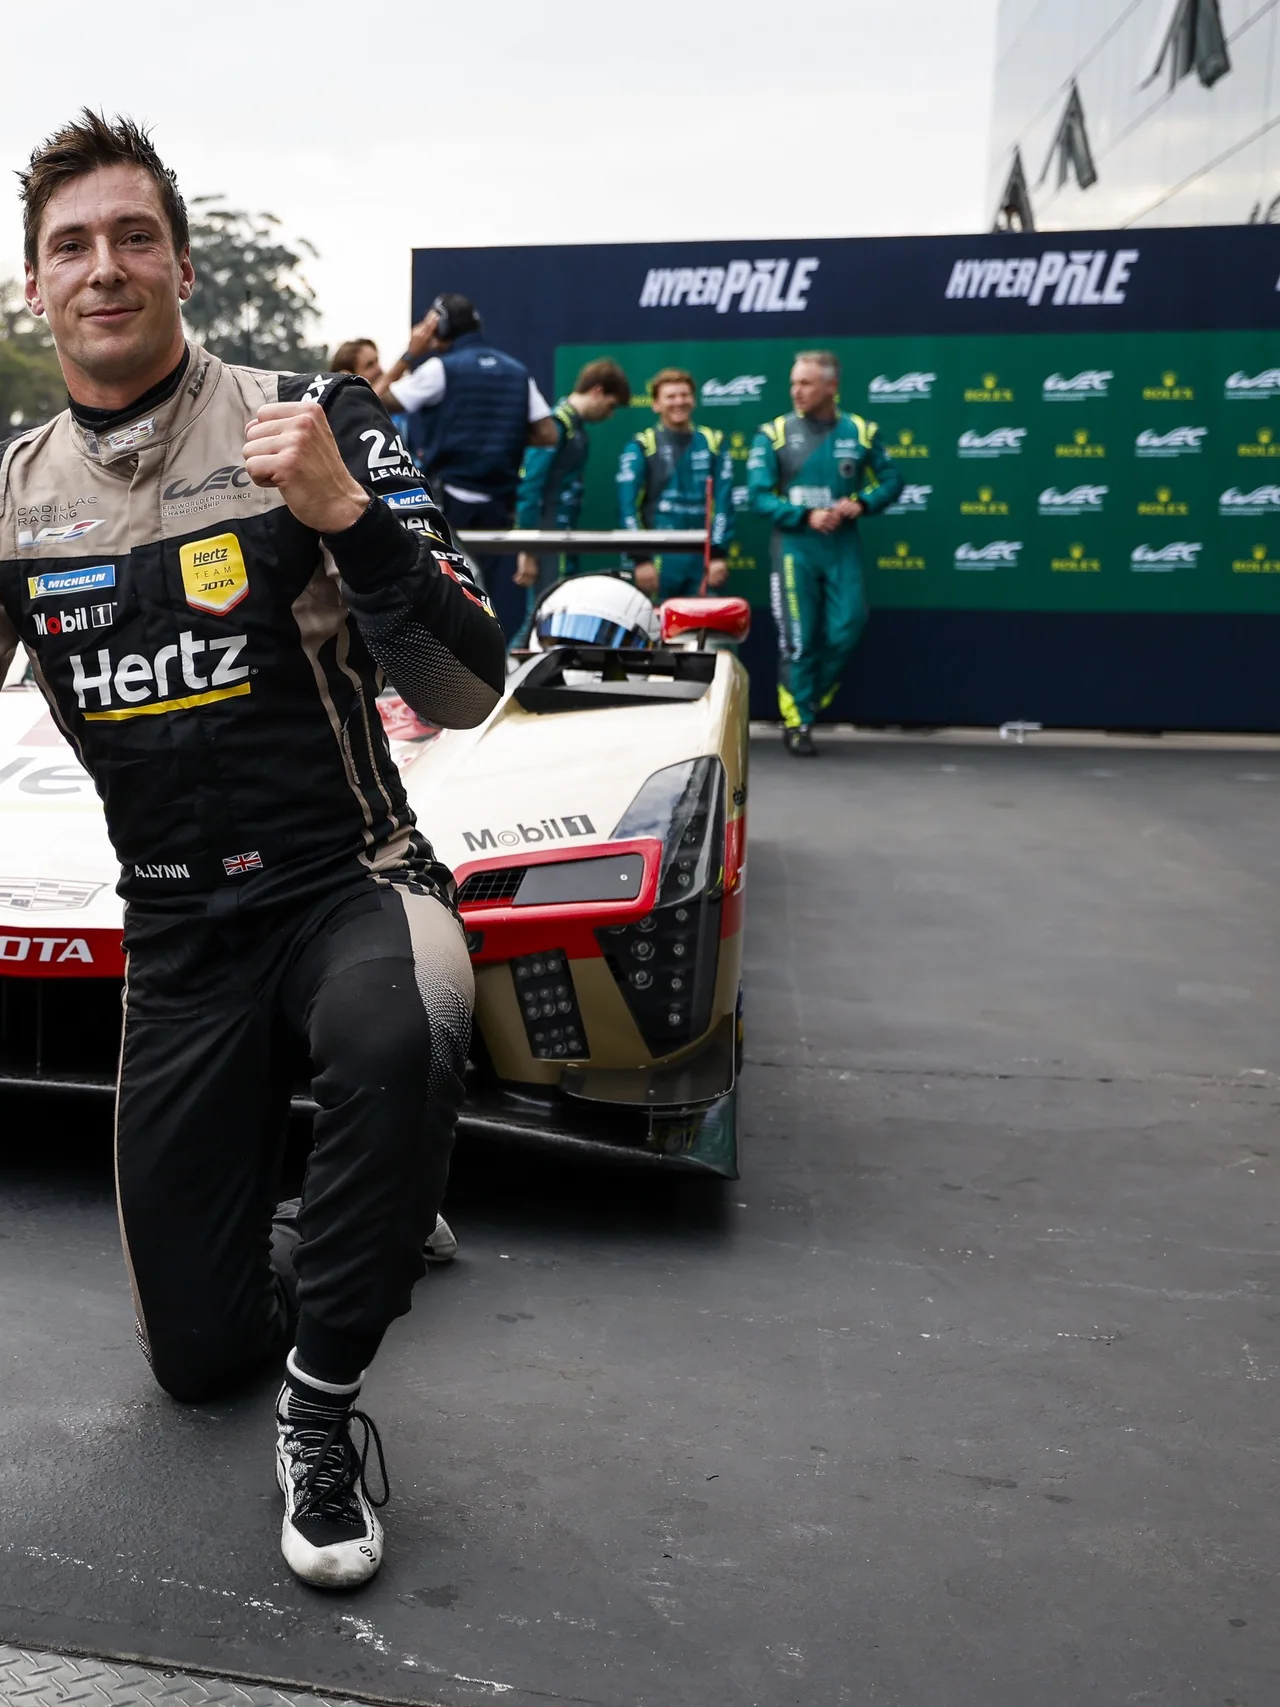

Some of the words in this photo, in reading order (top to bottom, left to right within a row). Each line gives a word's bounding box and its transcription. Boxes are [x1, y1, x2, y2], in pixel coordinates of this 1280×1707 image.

[702, 375, 767, 396] WEC
[868, 372, 937, 393] WEC
[1042, 370, 1114, 391] WEC
[957, 427, 1027, 448] WEC
[1135, 426, 1208, 447] WEC
[162, 465, 252, 501] WEC
[369, 468, 391, 482] LE
[162, 504, 176, 513] FIA
[176, 498, 205, 511] WORLD
[205, 492, 252, 504] ENDURANCE
[898, 484, 933, 505] EC
[1038, 484, 1109, 505] WEC
[17, 496, 98, 516] CADILLAC
[162, 501, 220, 518] CHAMPIONSHIP
[17, 509, 77, 527] RACING
[193, 547, 228, 565] Hertz
[954, 540, 1023, 561] WEC
[1131, 542, 1203, 562] WEC
[47, 571, 108, 590] MICHELIN
[194, 565, 232, 579] TEAM
[197, 578, 235, 592] JOTA
[32, 606, 88, 636] Mobil
[70, 630, 250, 709] Hertz
[462, 818, 564, 852] Mobil
[134, 863, 191, 880] A.LYNN
